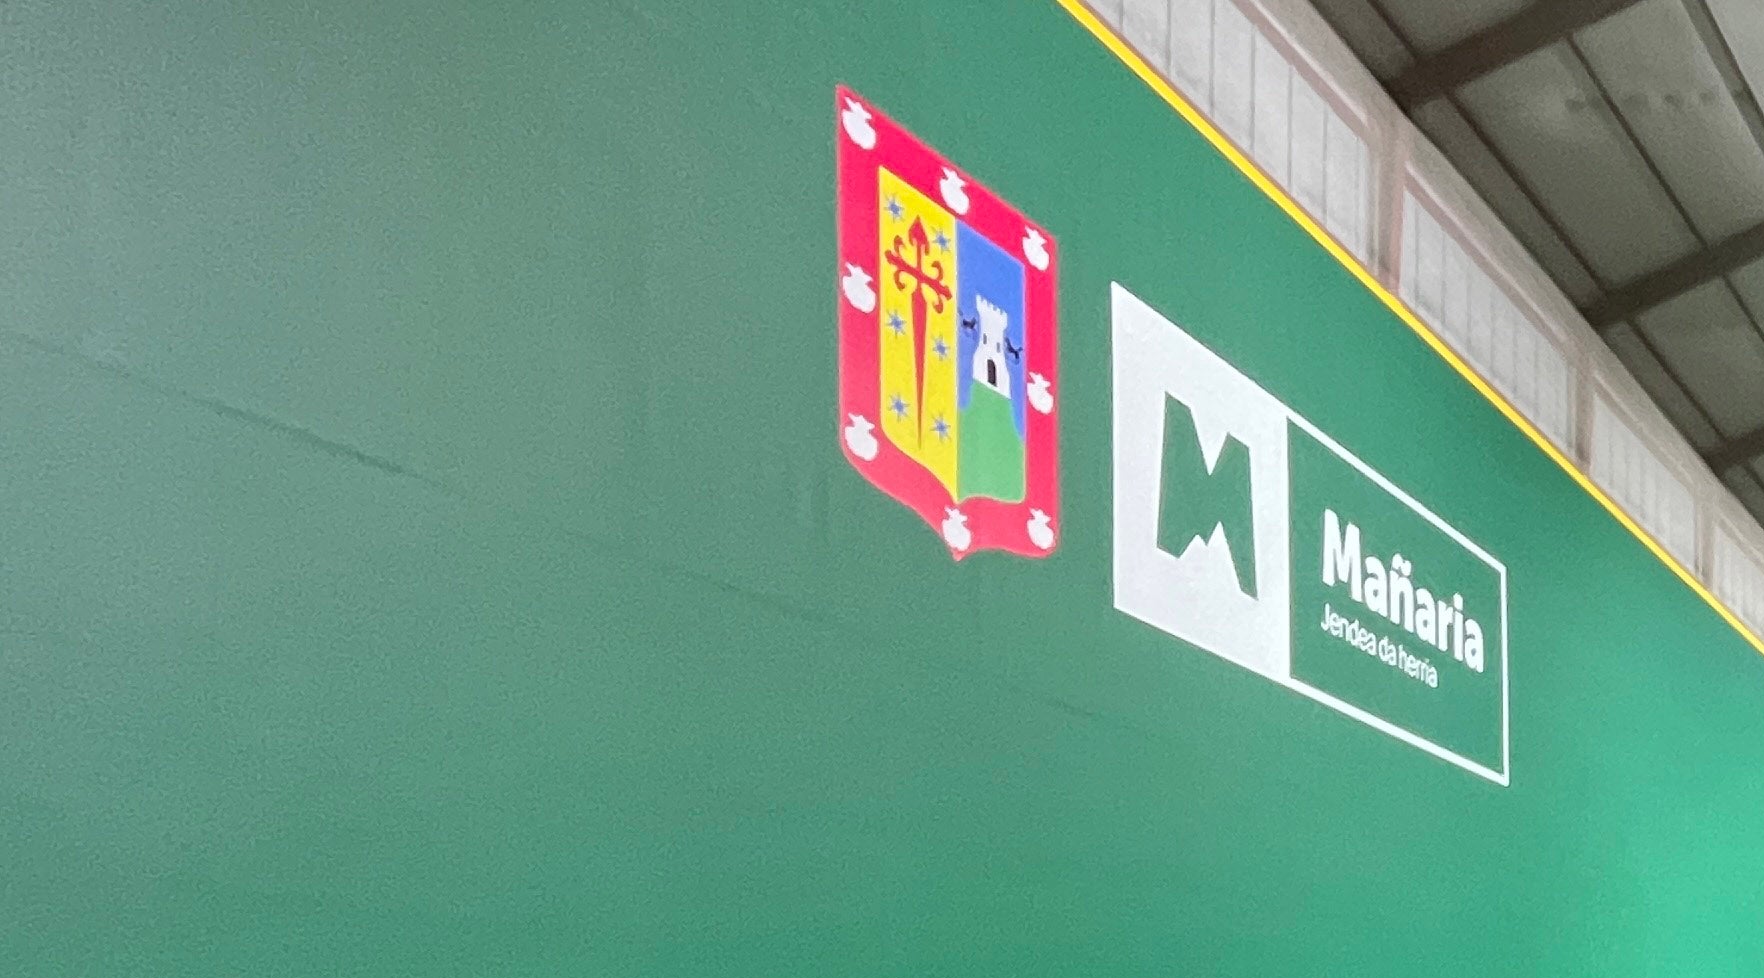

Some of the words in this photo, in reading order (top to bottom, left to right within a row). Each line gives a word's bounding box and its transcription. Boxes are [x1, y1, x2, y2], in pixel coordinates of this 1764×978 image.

[1320, 603, 1378, 656] Jendea
[1378, 635, 1397, 666] da
[1398, 644, 1438, 688] herria
[1322, 508, 1484, 673] Mañaria
